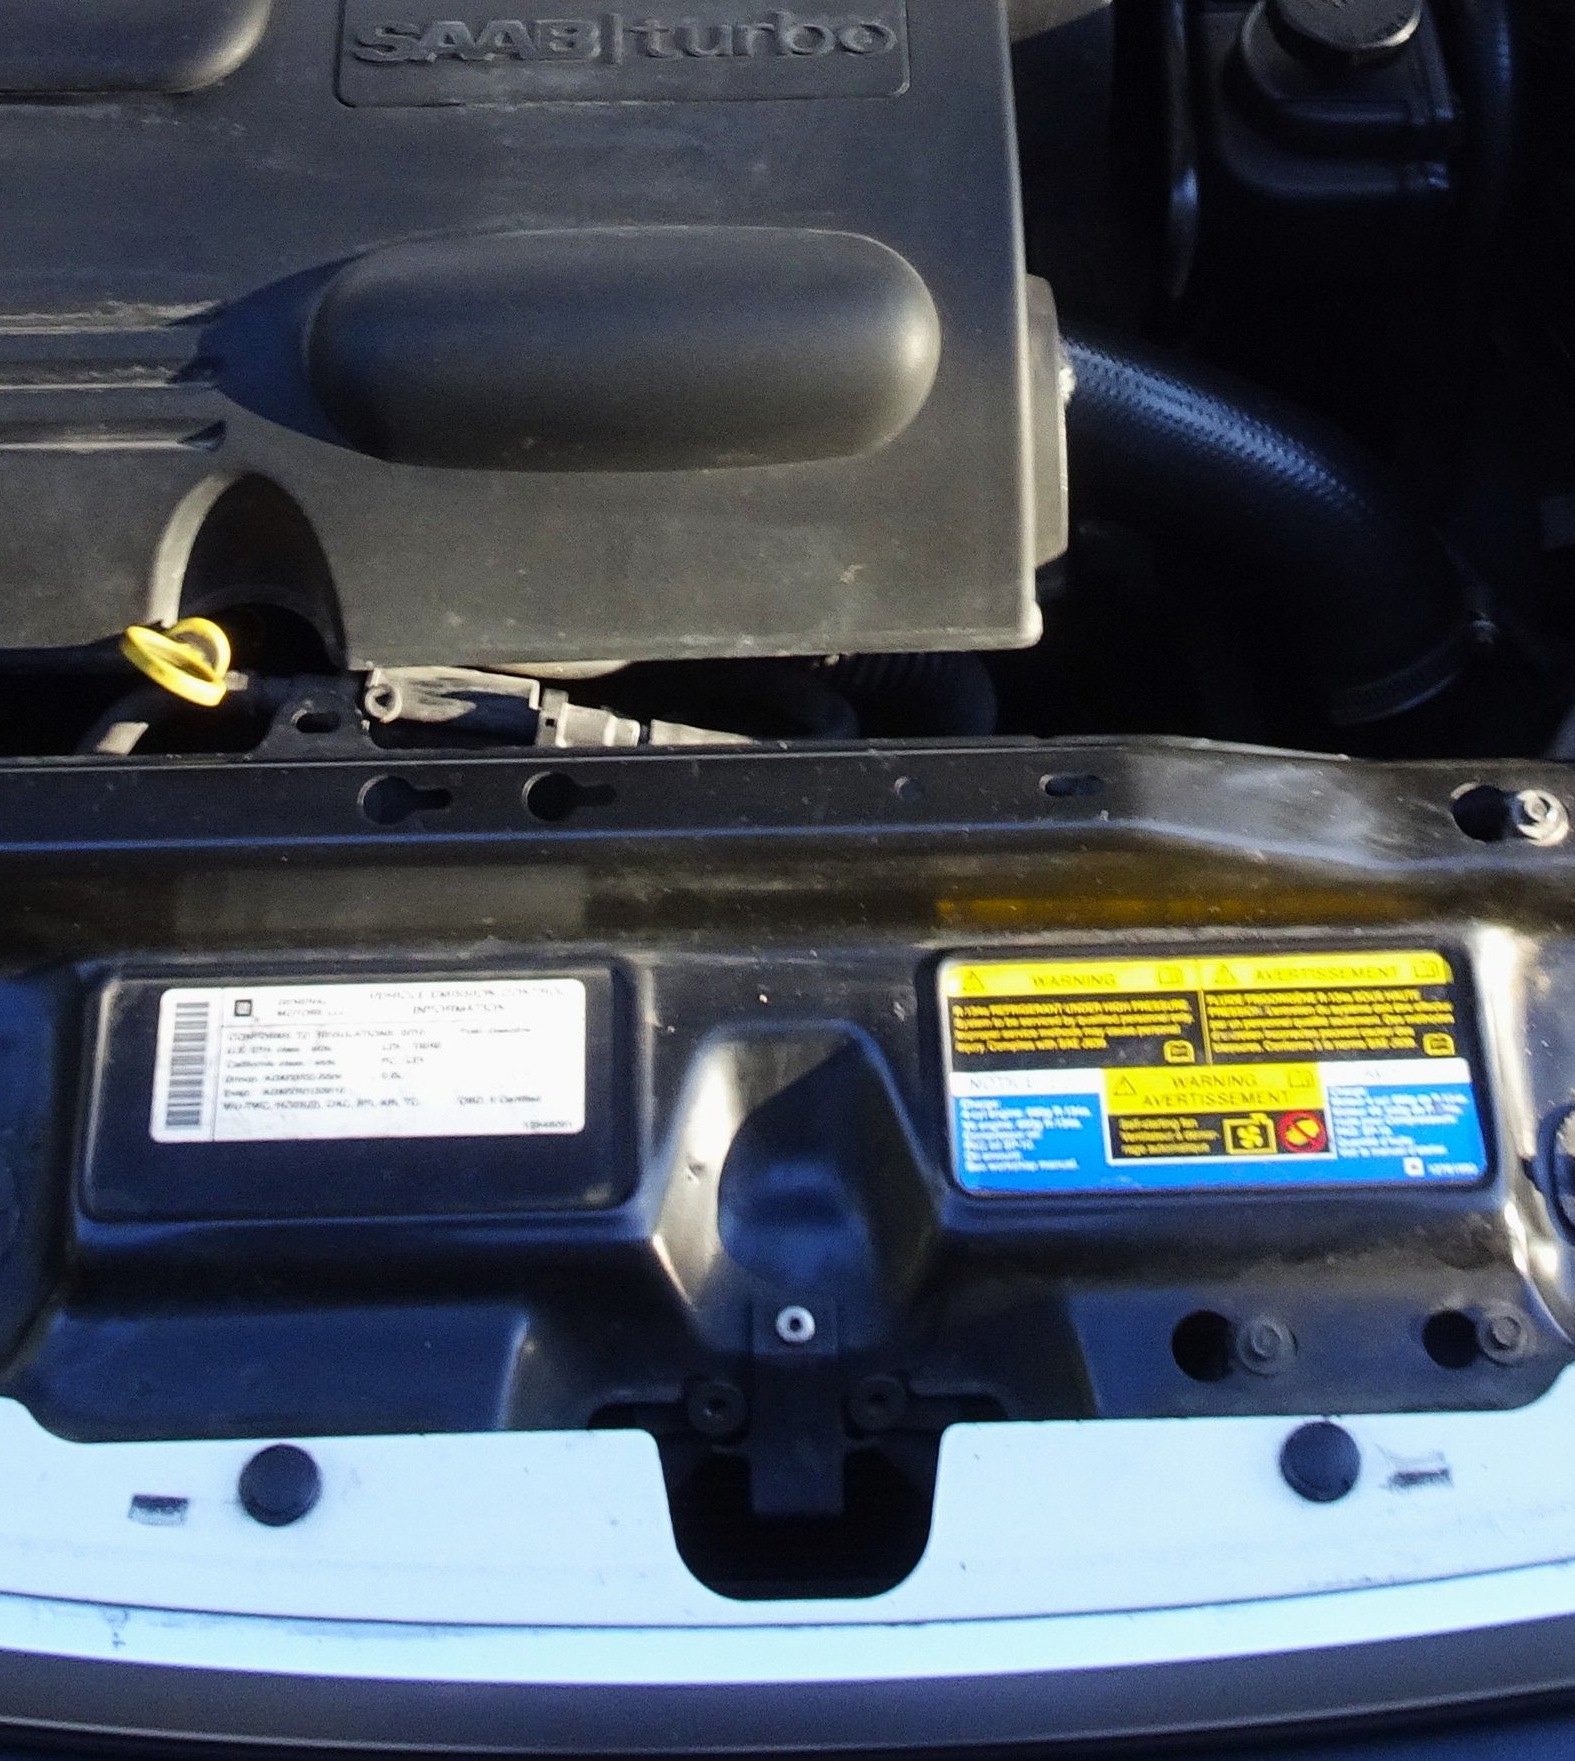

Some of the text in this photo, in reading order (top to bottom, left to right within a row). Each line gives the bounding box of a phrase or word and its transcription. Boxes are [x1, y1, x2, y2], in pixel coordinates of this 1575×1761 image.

[351, 8, 900, 65] SAAB turbo
[1032, 973, 1117, 989] WARNING
[1256, 964, 1398, 982] AVERTISSEMENT
[1172, 1073, 1258, 1089] WARNING
[1142, 1090, 1290, 1108] AVERTISSEMENT
